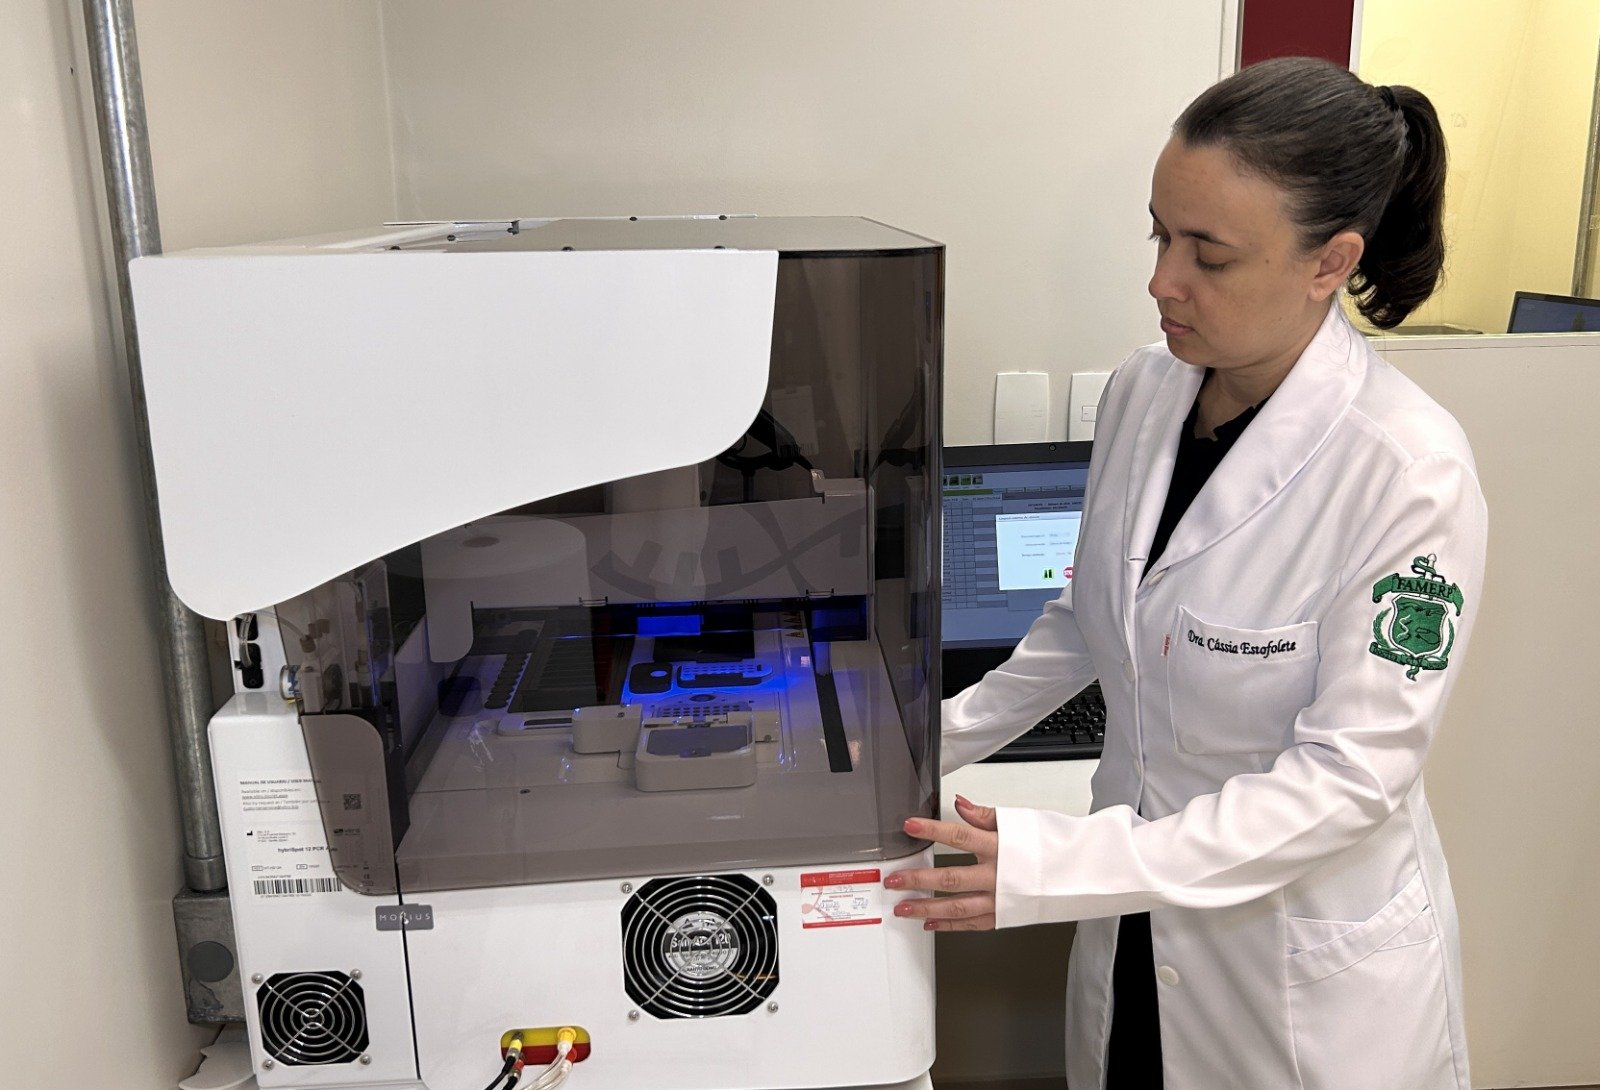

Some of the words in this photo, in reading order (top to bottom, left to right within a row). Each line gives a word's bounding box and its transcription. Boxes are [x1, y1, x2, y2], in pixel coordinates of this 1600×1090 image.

[1396, 578, 1453, 599] FAMERP
[1206, 638, 1239, 655] Cássia
[1240, 639, 1296, 658] Estofolete
